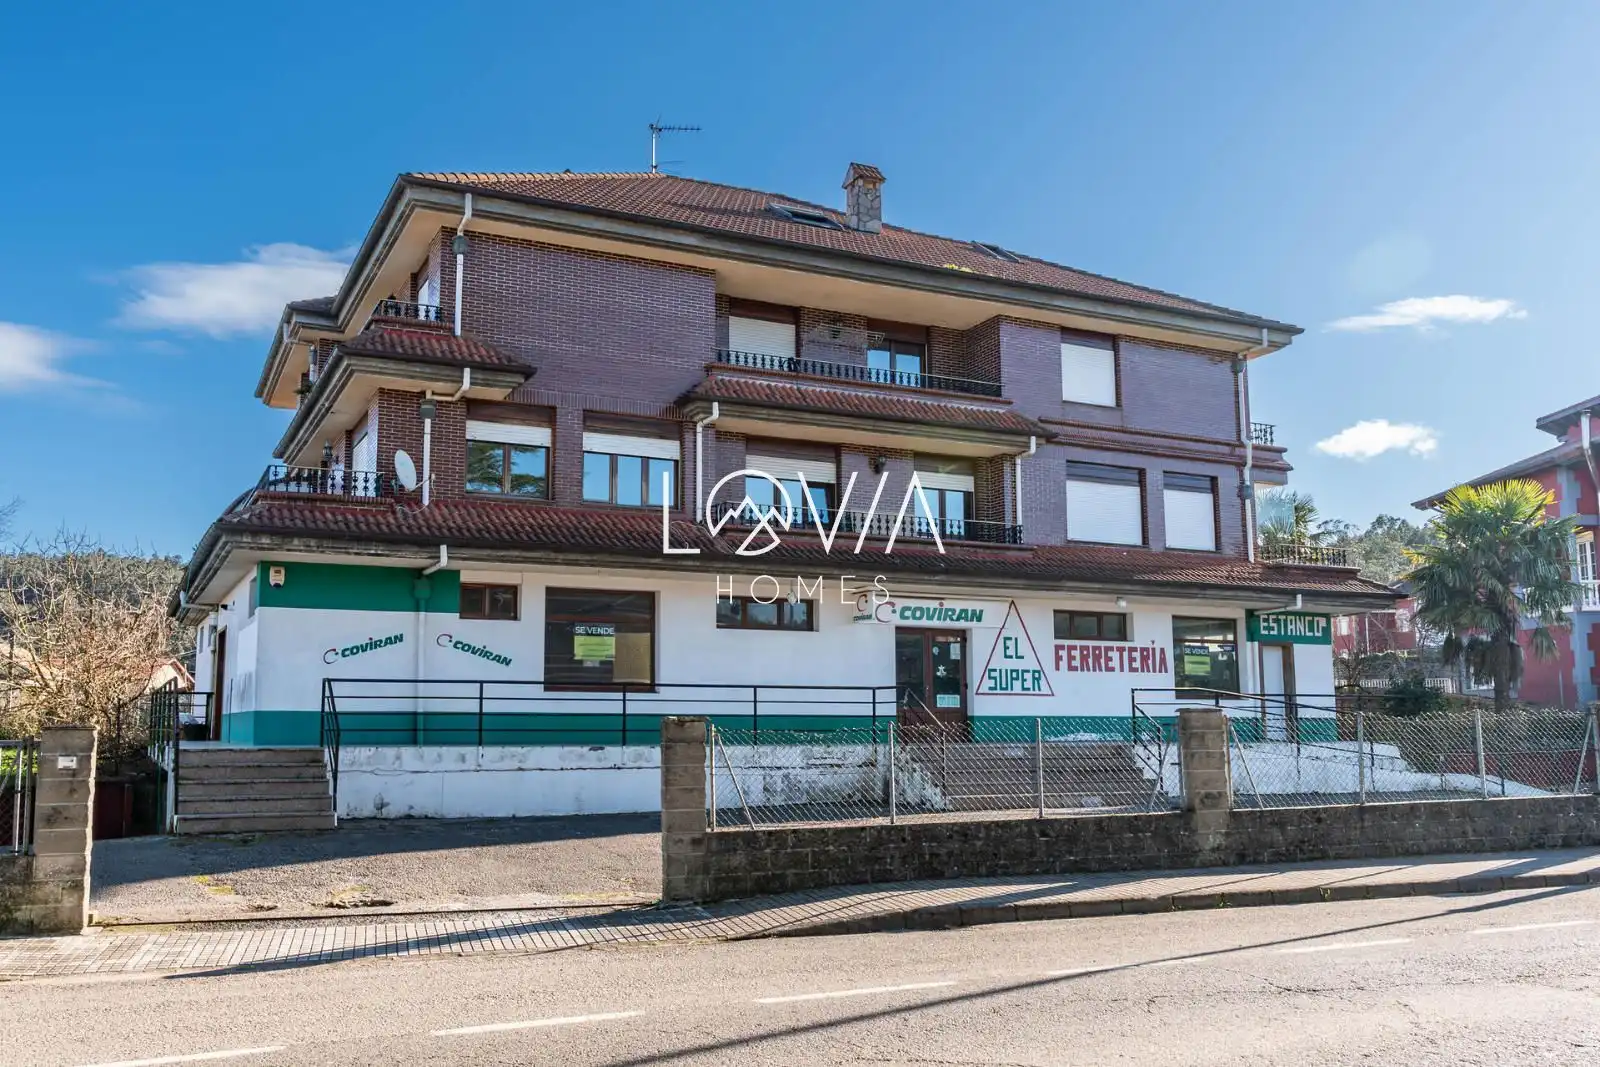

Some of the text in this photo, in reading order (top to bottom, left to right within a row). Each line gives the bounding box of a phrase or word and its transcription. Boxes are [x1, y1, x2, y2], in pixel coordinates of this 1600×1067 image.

[575, 626, 615, 635] SE VENDE
[1003, 636, 1025, 660] EL
[1054, 640, 1169, 674] FERRETERÍA
[987, 668, 1042, 692] SUPER
